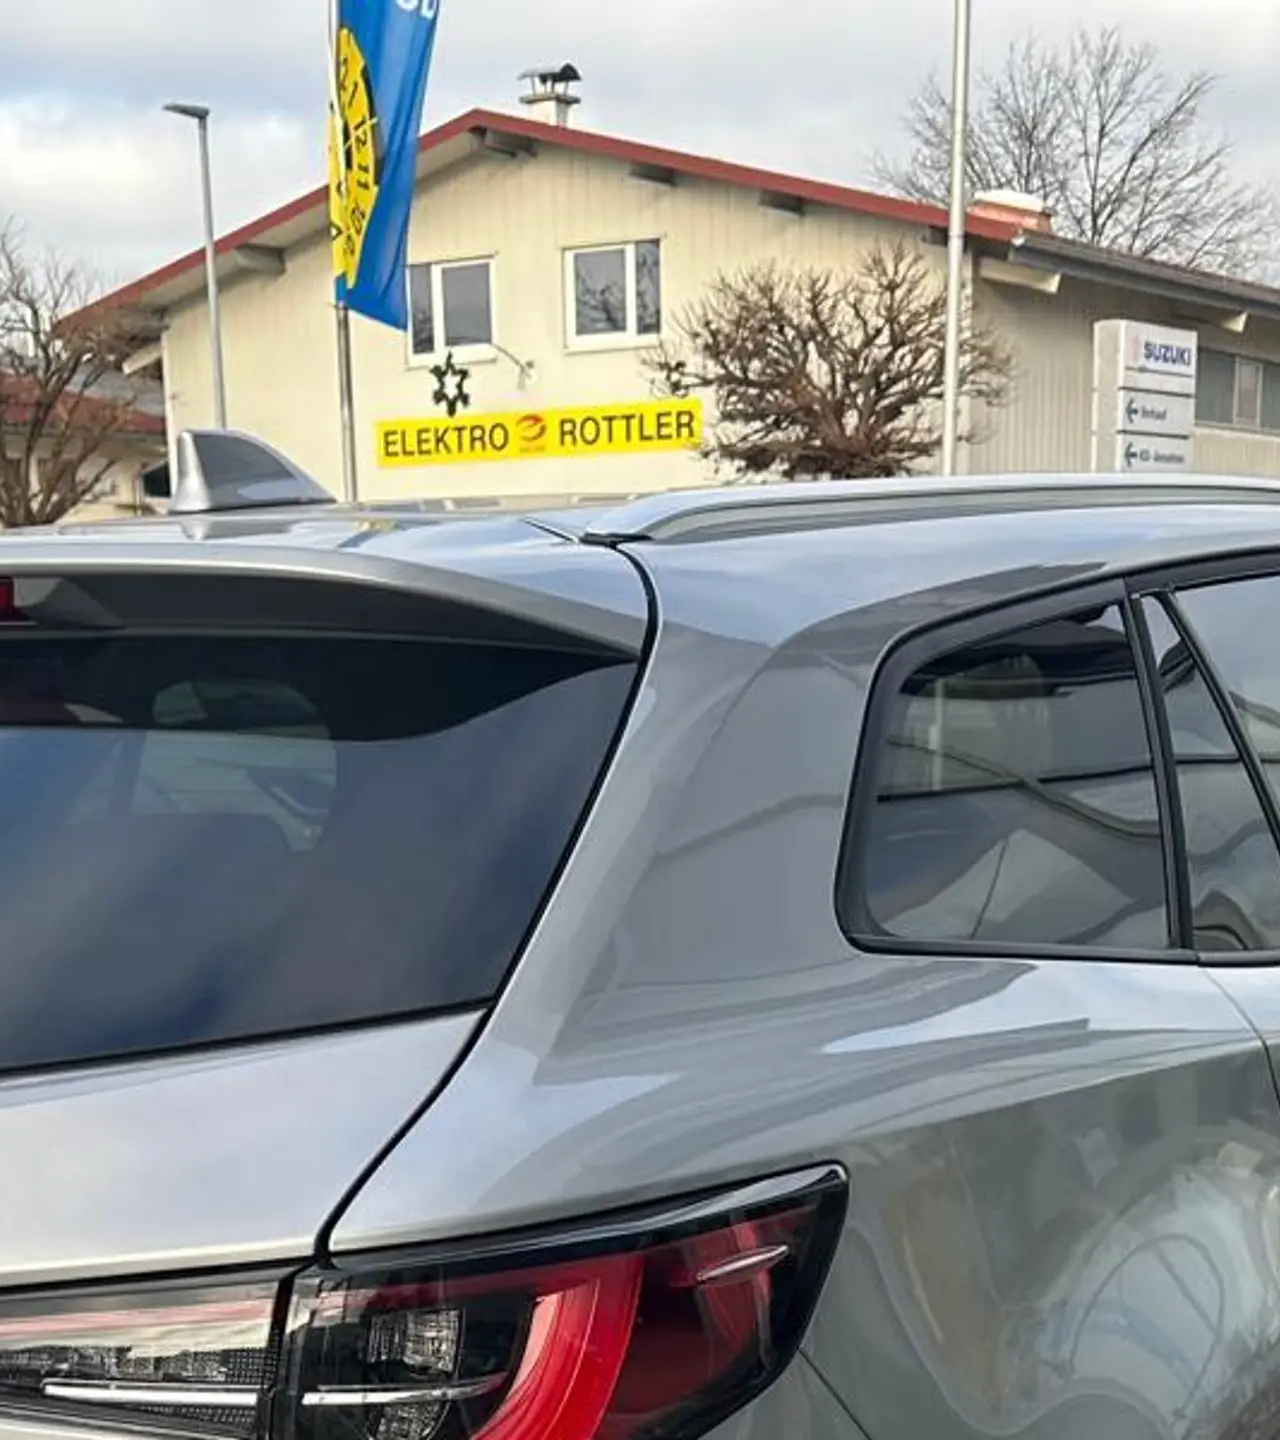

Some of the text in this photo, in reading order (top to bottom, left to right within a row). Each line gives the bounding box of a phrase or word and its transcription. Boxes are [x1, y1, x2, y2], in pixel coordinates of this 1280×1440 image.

[353, 116, 368, 153] 12
[1143, 341, 1191, 367] SUZUKI
[383, 410, 696, 457] ELEKTRO ROTTLER
